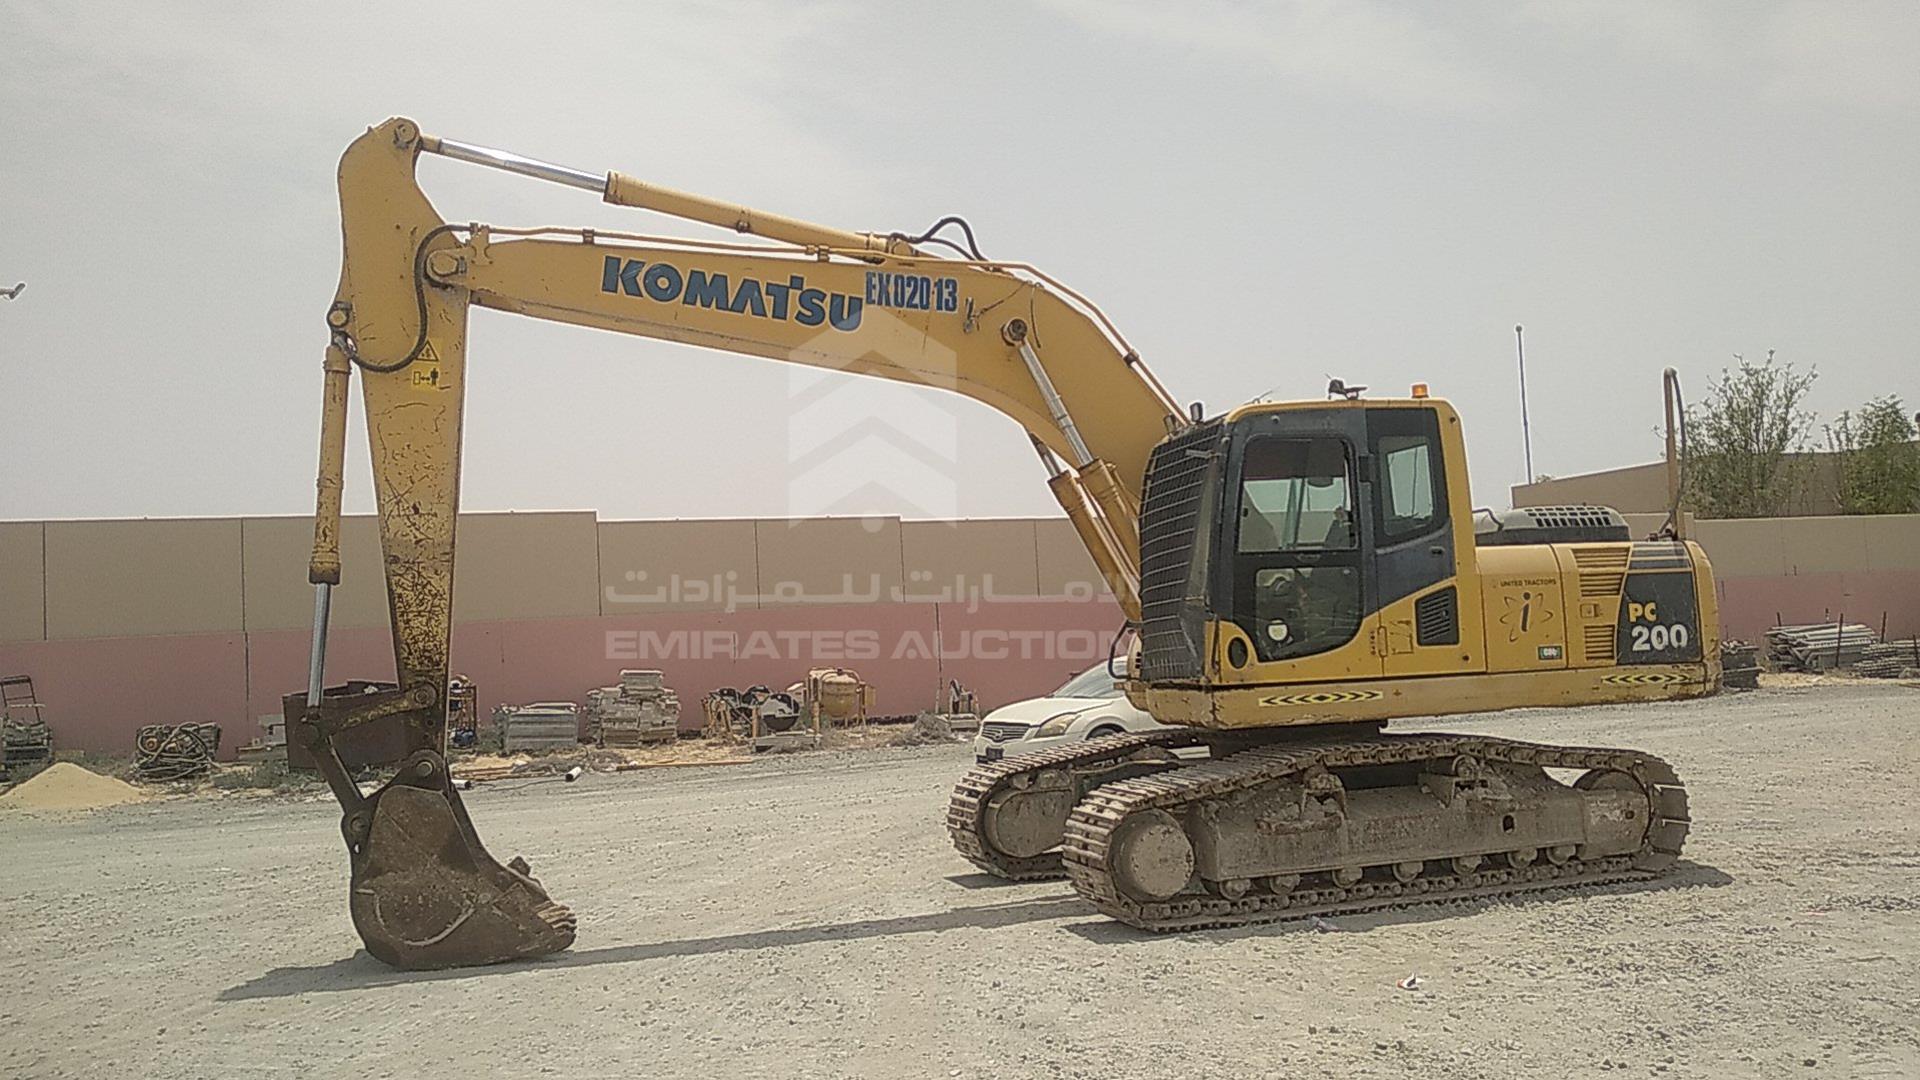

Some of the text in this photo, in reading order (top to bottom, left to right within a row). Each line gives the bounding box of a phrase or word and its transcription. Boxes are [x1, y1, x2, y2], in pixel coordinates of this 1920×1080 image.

[601, 255, 863, 332] KOMATSU
[1500, 578, 1557, 588] UNITED TRACTORS
[1628, 602, 1657, 622] PC
[1631, 624, 1688, 651] 200
